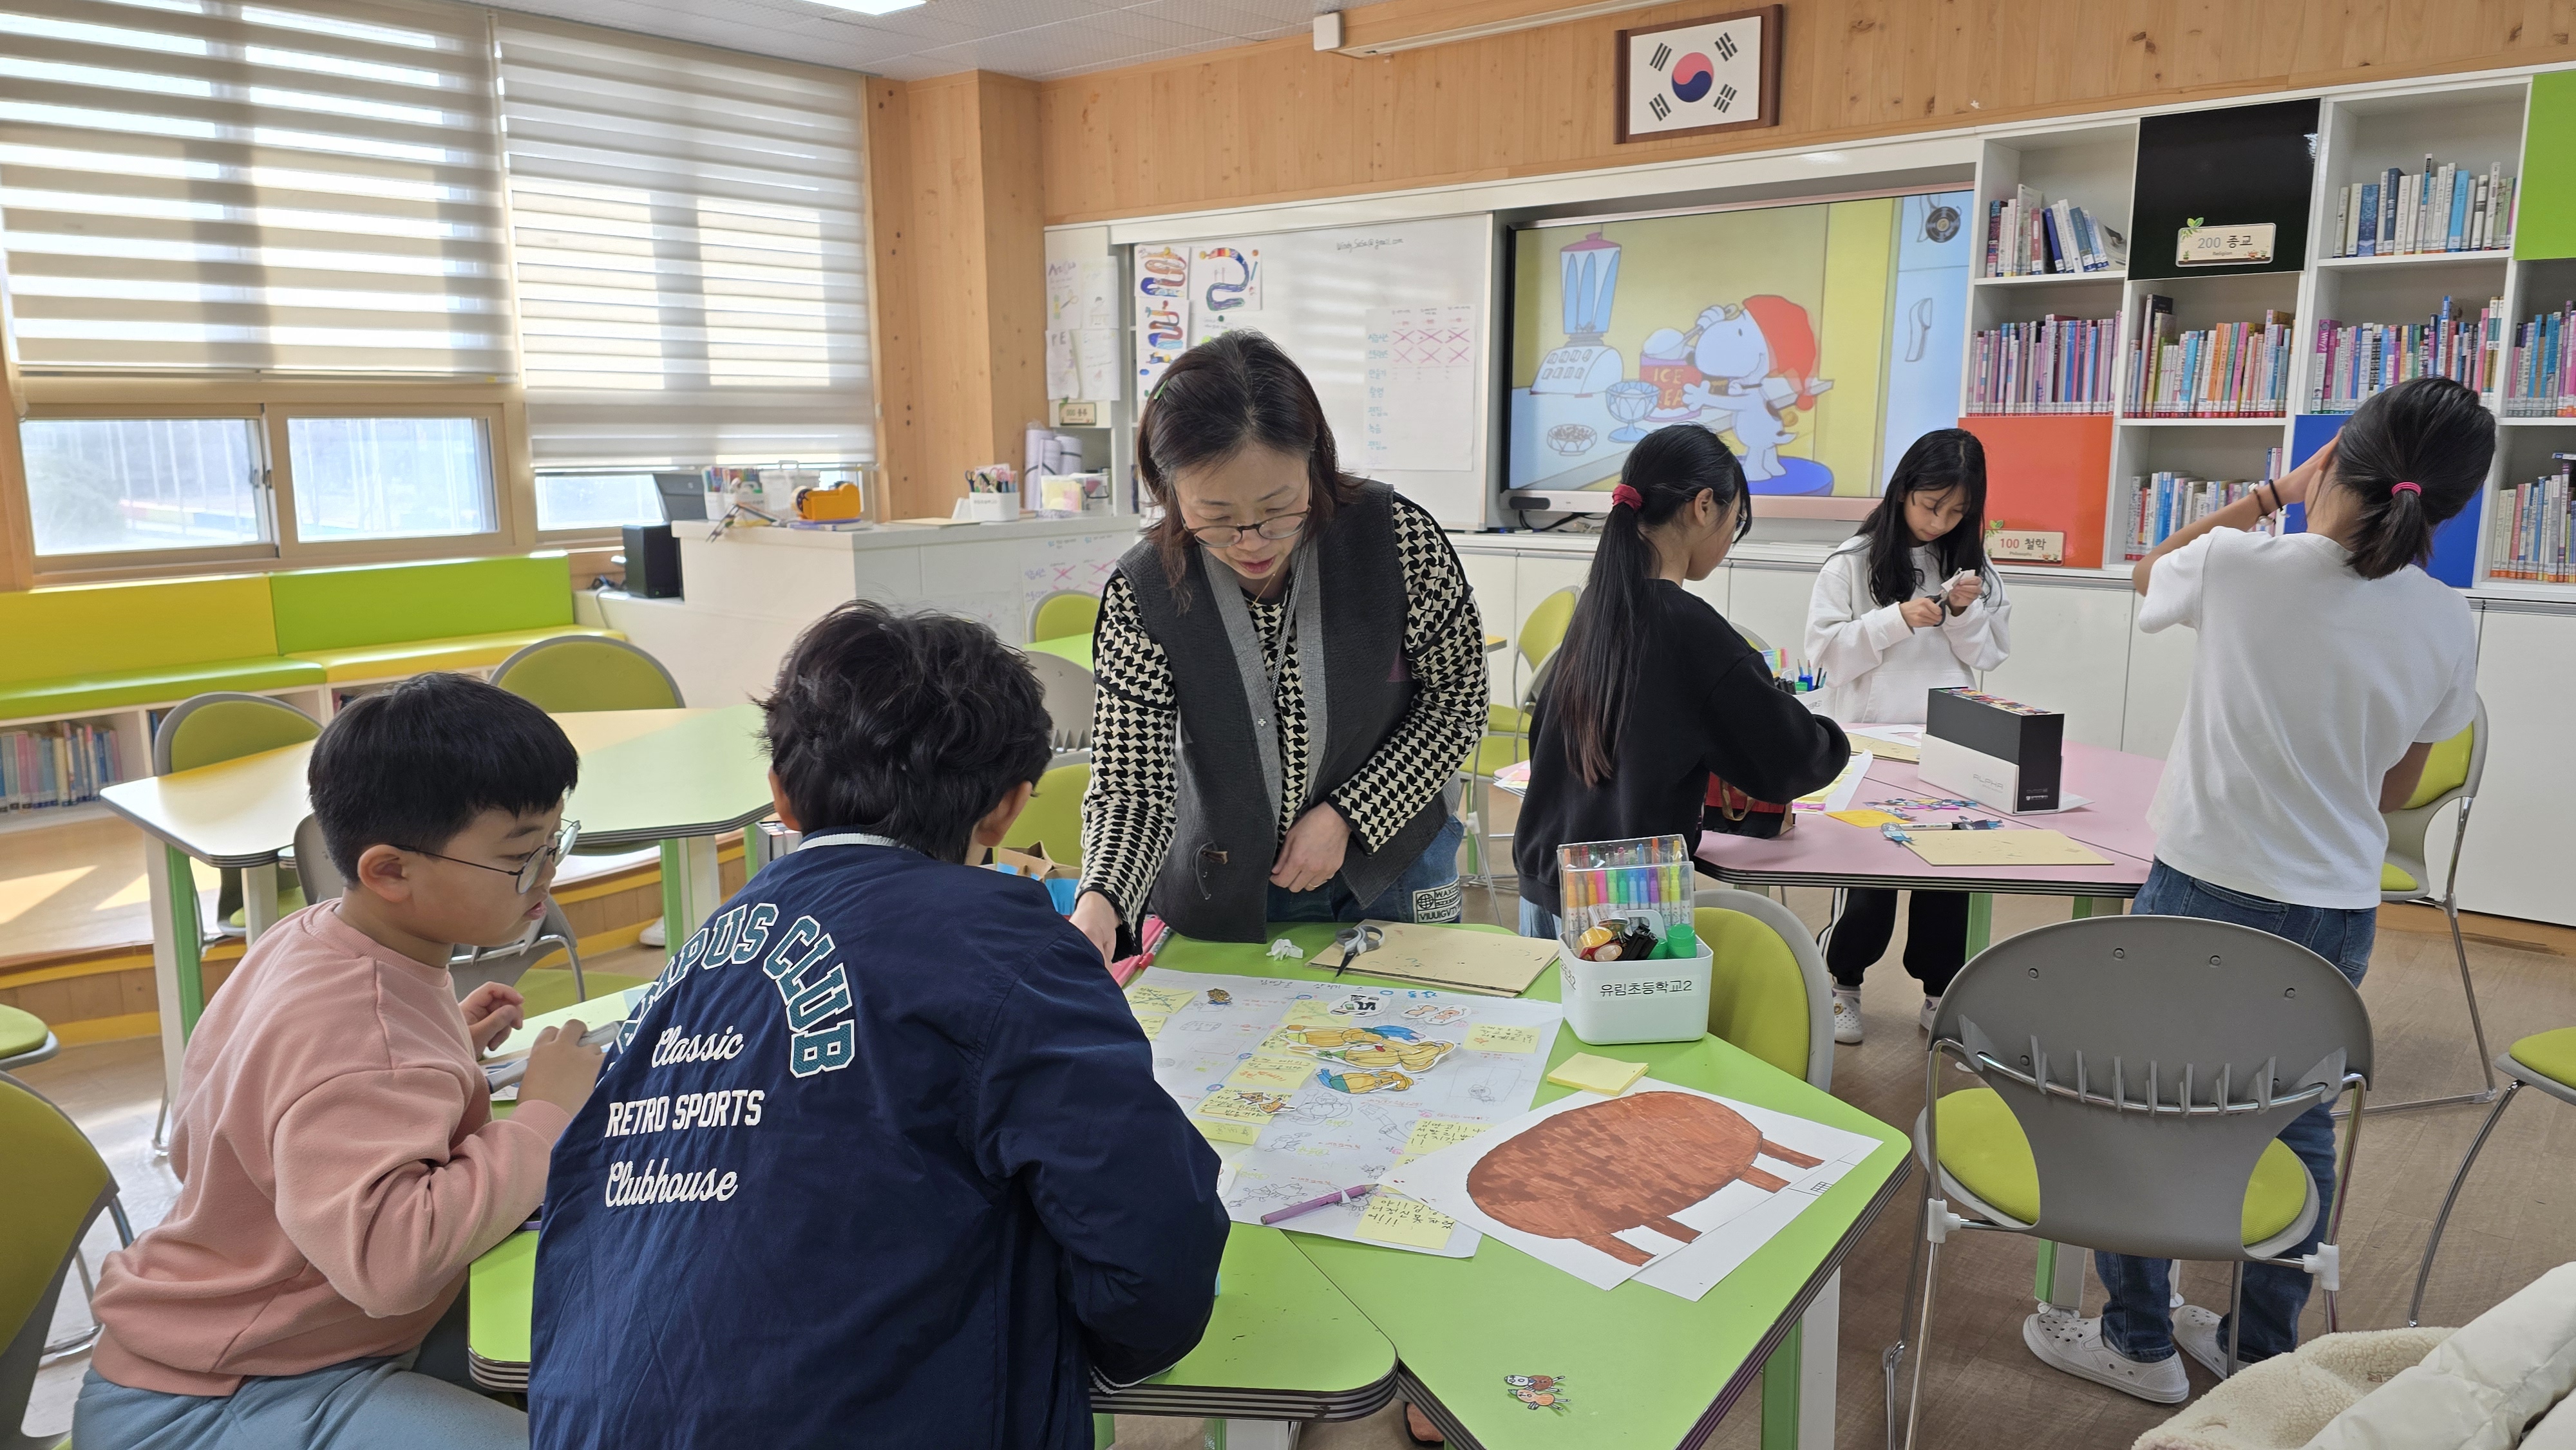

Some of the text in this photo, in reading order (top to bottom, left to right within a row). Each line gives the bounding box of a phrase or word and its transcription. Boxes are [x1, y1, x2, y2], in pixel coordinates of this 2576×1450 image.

[2197, 235, 2253, 249] 200 종교
[2318, 332, 2329, 352] Why?
[1653, 368, 1684, 384] ICE
[2000, 538, 2047, 550] 100 철학
[1973, 773, 2004, 790] ALPHA
[596, 903, 856, 1086] AMPUS CLUB
[1599, 980, 1693, 997] 유림초등학교2
[651, 1025, 744, 1068] Classic
[604, 1089, 766, 1138] RETRO SPORTS
[605, 1158, 739, 1208] Clubhouse
